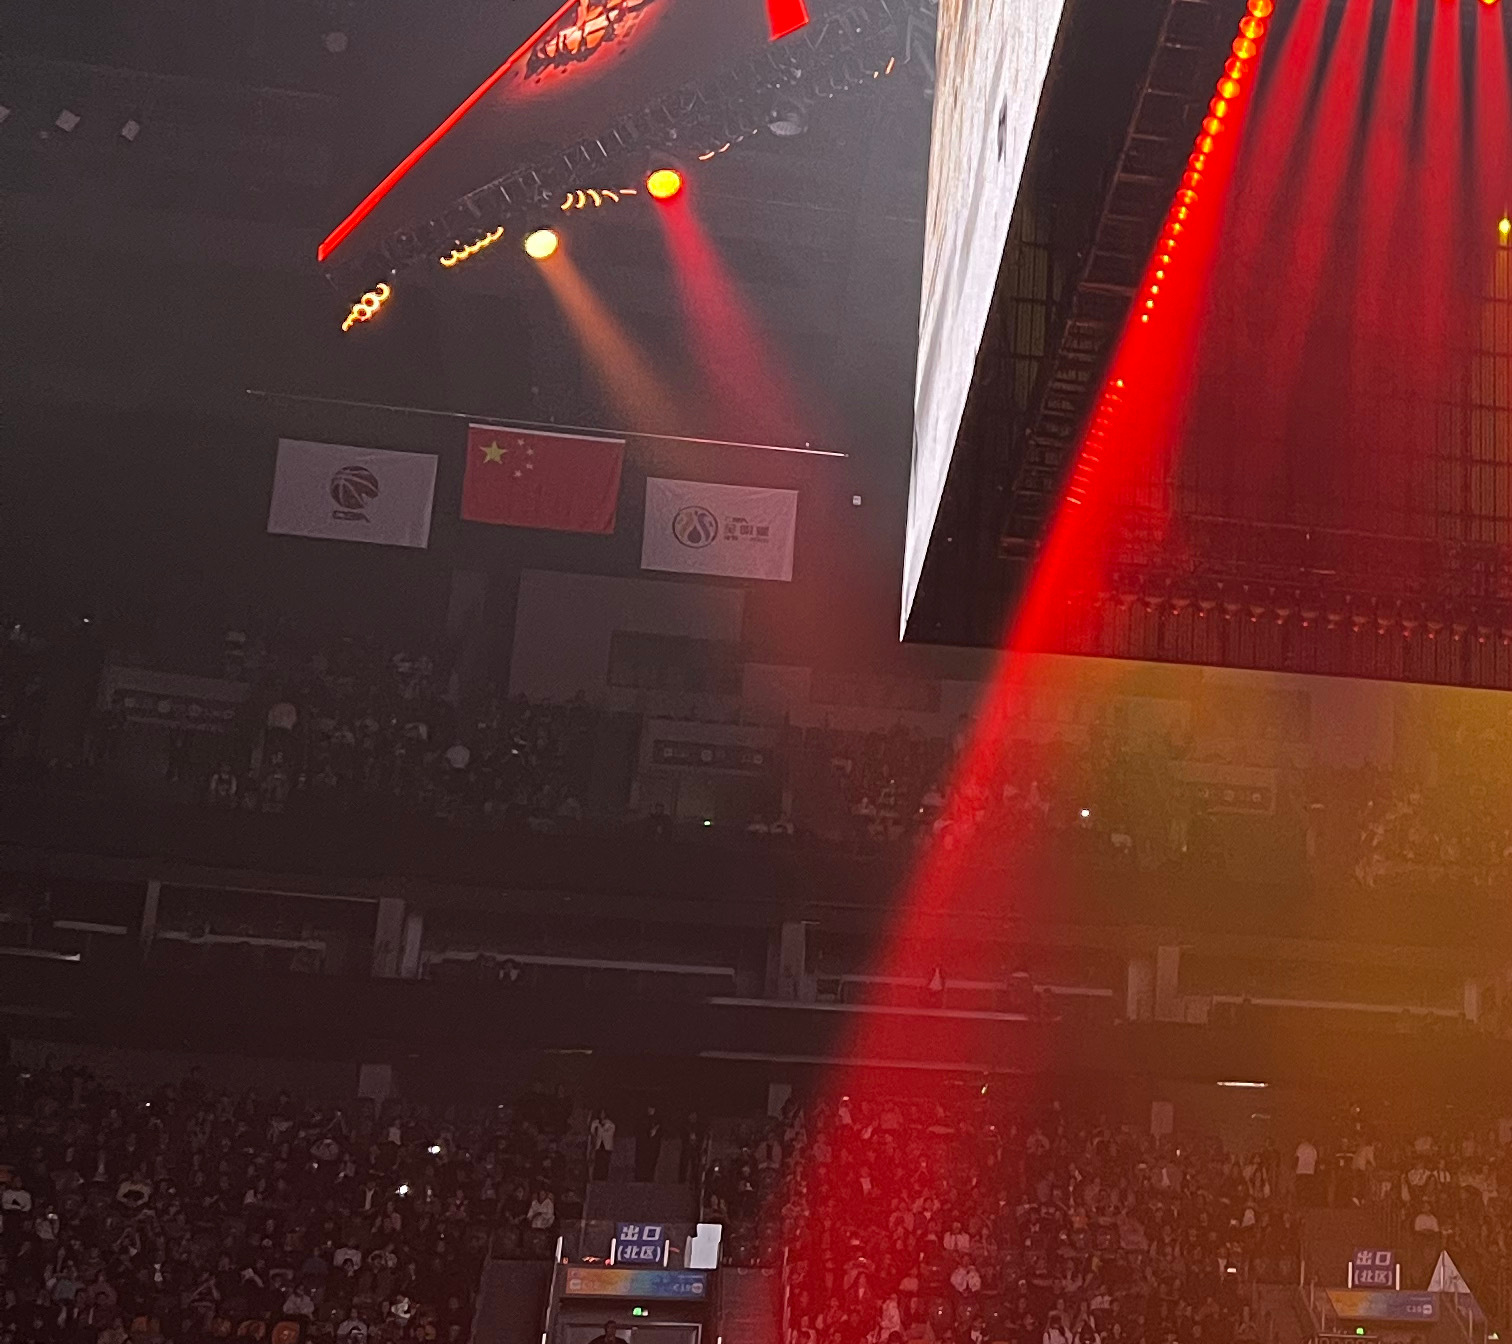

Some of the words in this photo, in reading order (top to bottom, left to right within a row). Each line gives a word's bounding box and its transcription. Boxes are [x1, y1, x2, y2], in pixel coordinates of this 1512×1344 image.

[620, 1225, 662, 1241] 出口
[617, 1245, 661, 1262] (北区)
[1356, 1250, 1392, 1265] 出口
[1354, 1269, 1393, 1286] (北区)
